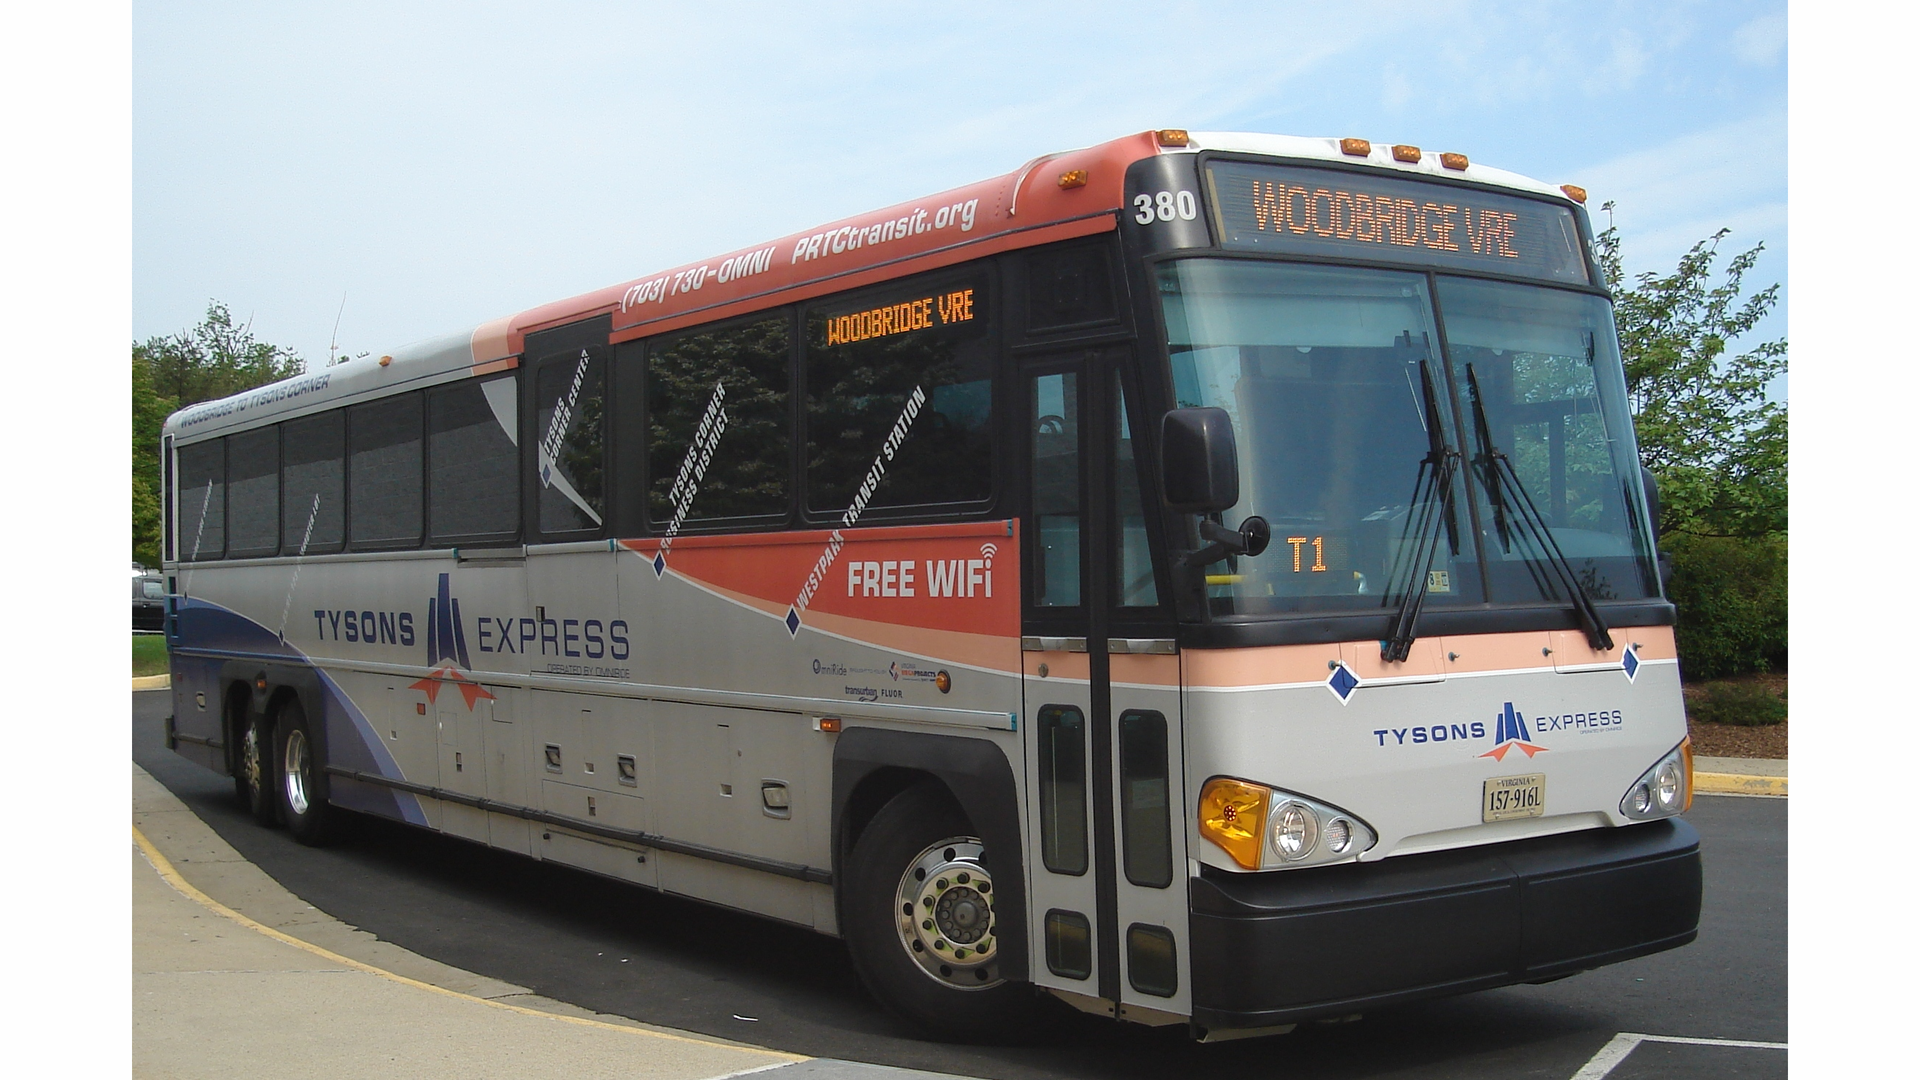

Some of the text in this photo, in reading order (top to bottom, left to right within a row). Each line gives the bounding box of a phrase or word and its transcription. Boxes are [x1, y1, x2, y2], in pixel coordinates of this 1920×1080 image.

[1133, 190, 1197, 225] 380
[1253, 180, 1519, 258] WOODBRIDGE VRE
[621, 199, 979, 313] (703) 730-OMNI PRTCtransit.org
[827, 289, 974, 347] WOODBRIDGE VRE
[181, 374, 331, 428] WOODBRIDGE TO TYSONS CORNER
[543, 397, 565, 454] TYSONS
[550, 348, 591, 467] CORNER CENTER
[668, 382, 726, 507] TYSONS CORNER
[660, 407, 729, 556] BUSINESS DISTRICT
[796, 385, 926, 612] WESTPARK TRANSIT STATION
[847, 561, 915, 597] FREE
[1287, 536, 1327, 572] T1
[314, 610, 630, 660] TYSONS EXPRESS
[813, 659, 847, 676] OmniRide
[881, 688, 903, 698] FLUOR
[1373, 710, 1622, 746] TYSONS EXPRESS
[1501, 777, 1530, 787] VIRGINIA
